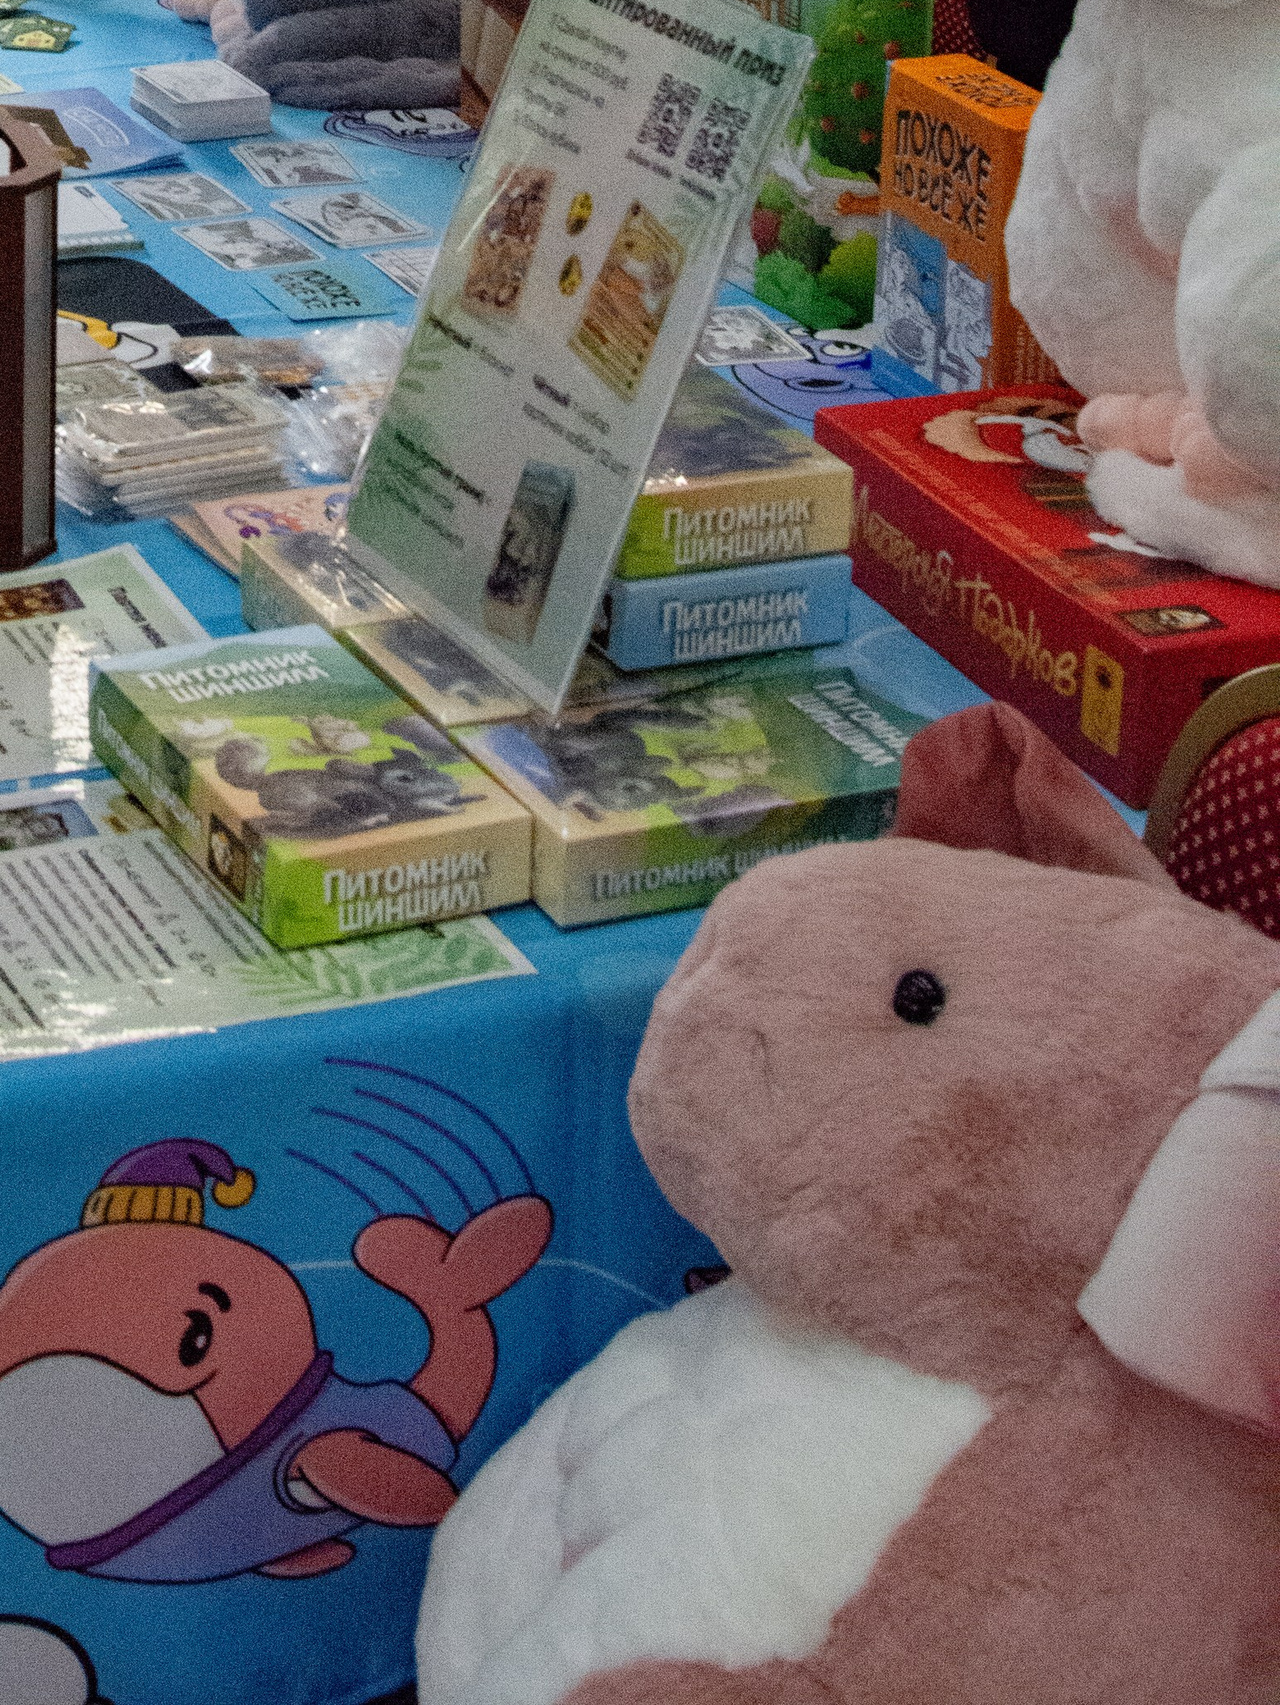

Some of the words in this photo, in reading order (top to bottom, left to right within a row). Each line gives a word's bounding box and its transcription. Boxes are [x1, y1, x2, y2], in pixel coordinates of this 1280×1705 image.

[729, 43, 789, 91] приз
[896, 108, 992, 204] ПОХОЖЕ
[894, 160, 915, 198] НО
[958, 188, 989, 243] ЖЕ
